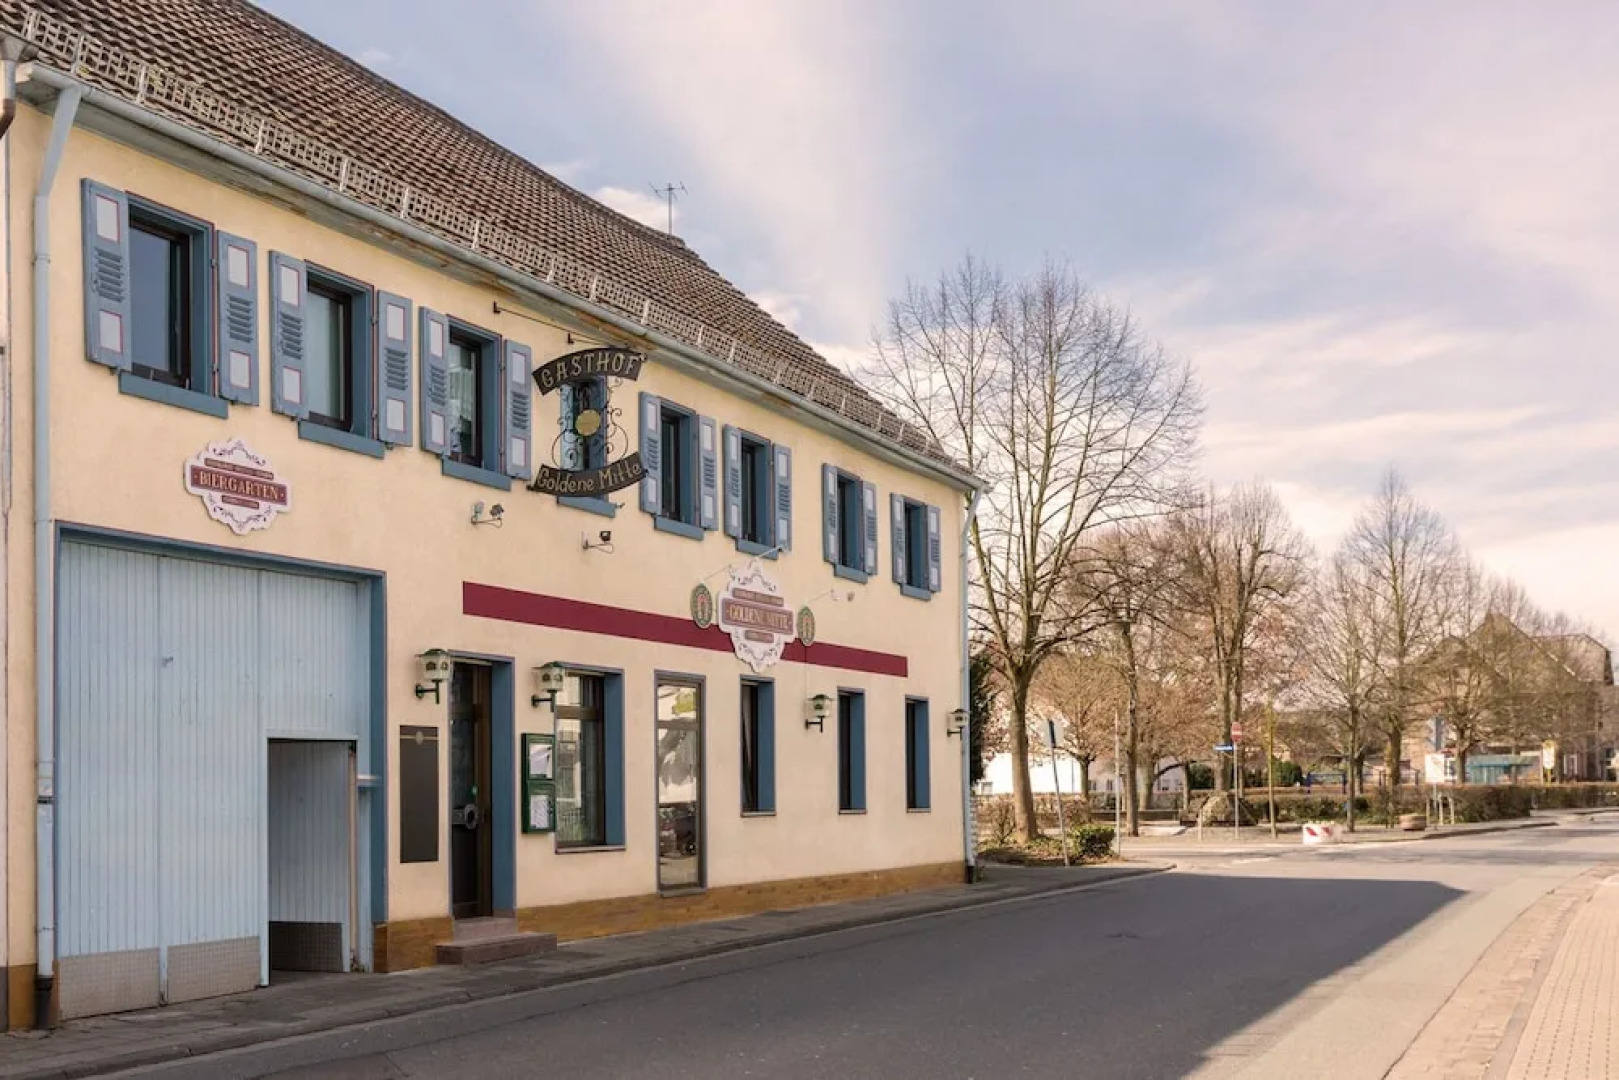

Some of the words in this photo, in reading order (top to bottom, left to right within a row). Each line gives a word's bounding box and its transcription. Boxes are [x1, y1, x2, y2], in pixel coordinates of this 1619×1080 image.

[541, 351, 639, 388] GASTHOF
[199, 470, 278, 500] BIERGARTEN
[537, 467, 595, 493] Goldene
